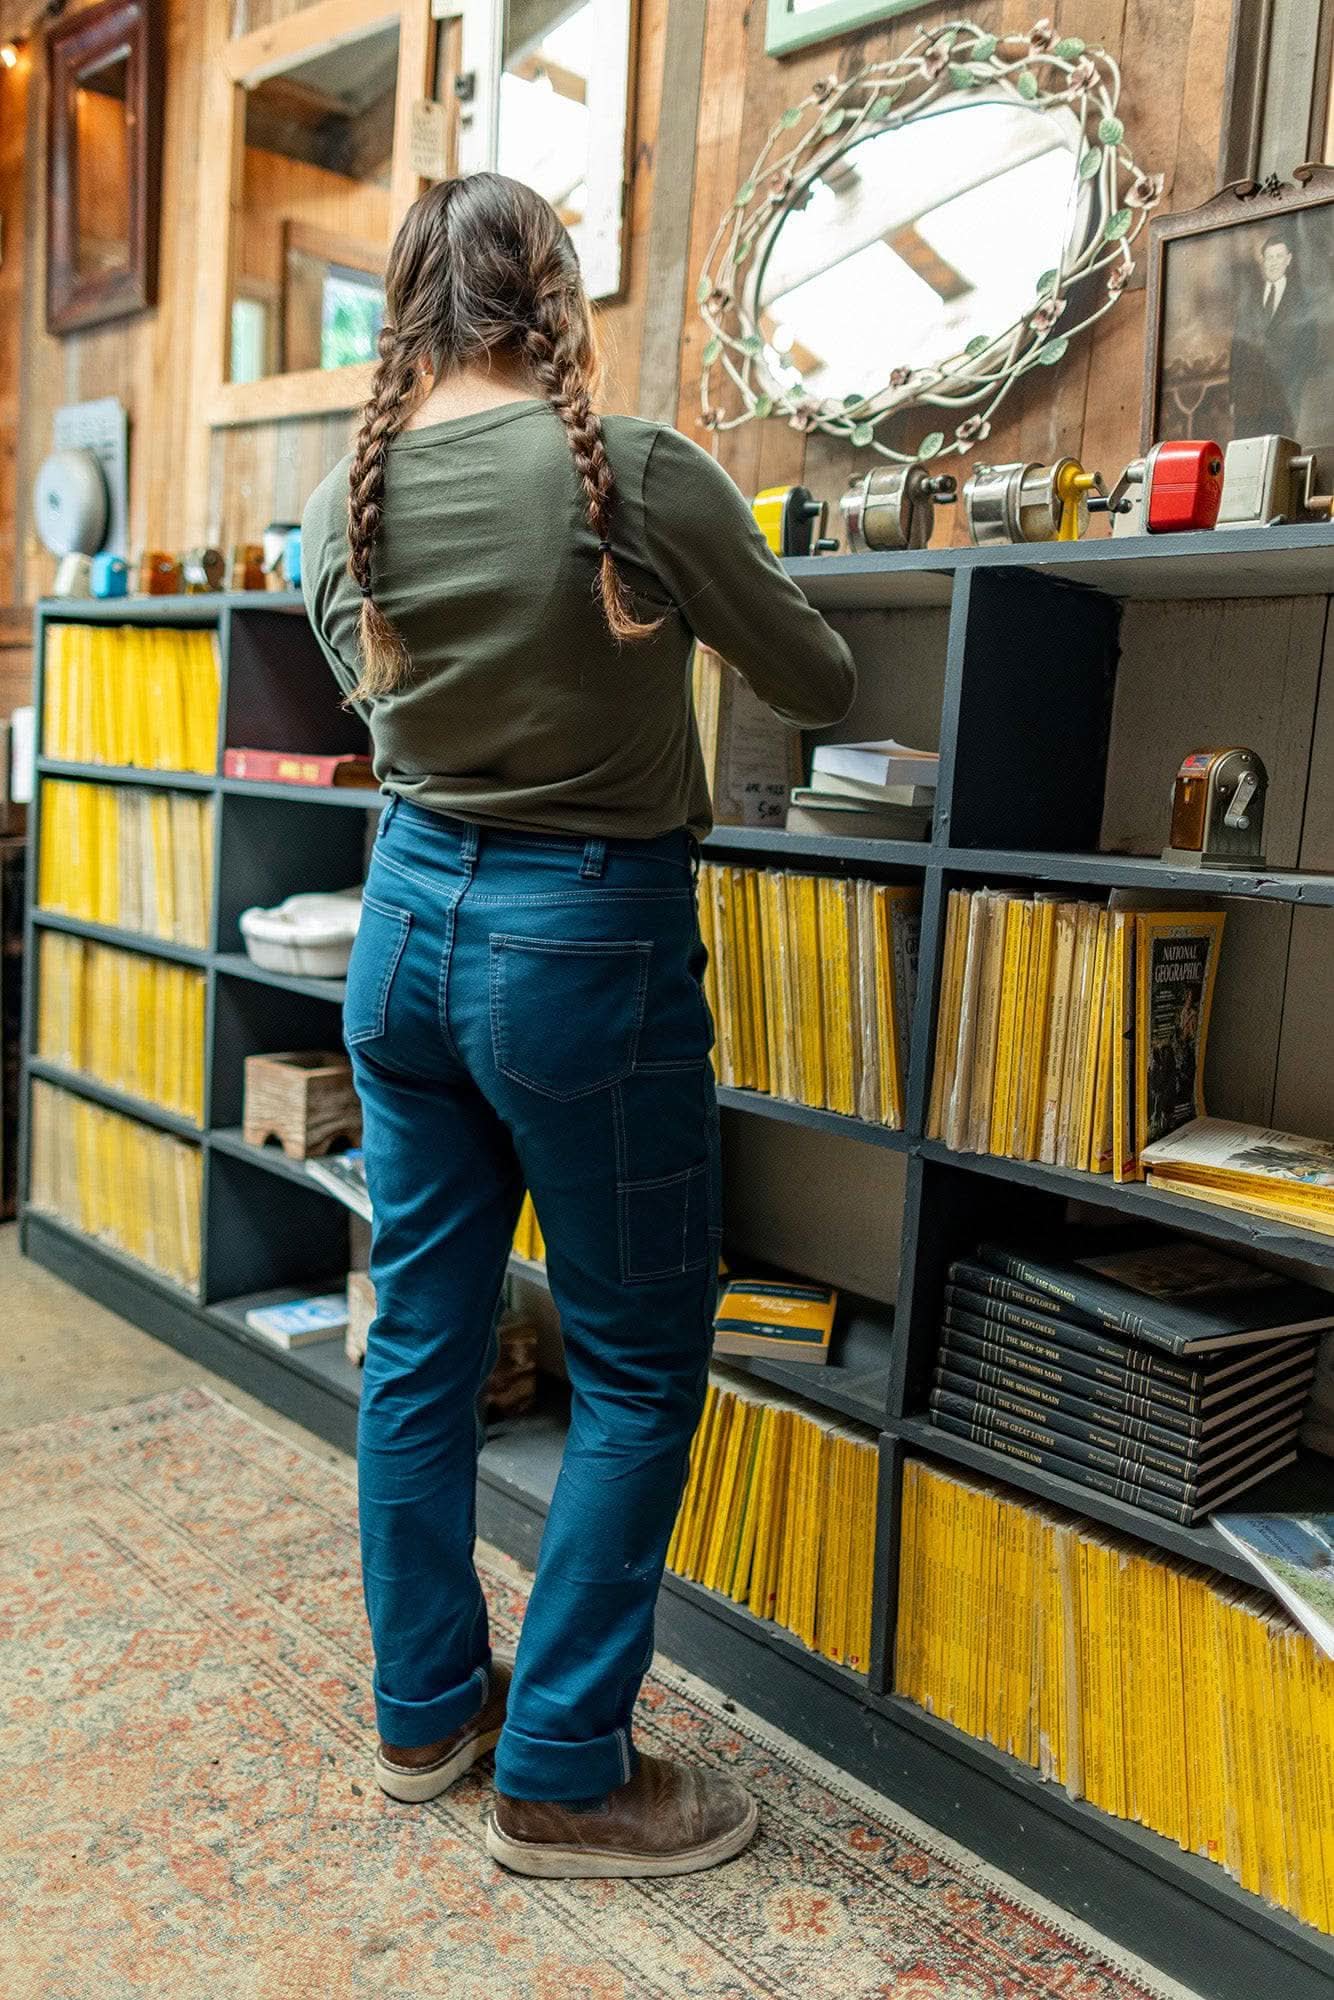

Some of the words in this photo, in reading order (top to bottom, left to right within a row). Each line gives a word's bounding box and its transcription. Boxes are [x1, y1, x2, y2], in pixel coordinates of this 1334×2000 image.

[1163, 945, 1197, 961] NATIONAL
[1155, 962, 1203, 983] GEOGRAPHIC
[1011, 1290, 1025, 1301] THE
[1025, 1295, 1061, 1313] EXPLORERS
[1008, 1313, 1020, 1323] THE
[1021, 1318, 1057, 1336] EXPLORERS
[1006, 1335, 1019, 1345] THE
[1004, 1356, 1018, 1367] THE
[1044, 1367, 1063, 1382] MAIN
[1002, 1377, 1015, 1387] THE
[1041, 1391, 1060, 1405] MAIN
[998, 1398, 1011, 1409] THE
[995, 1418, 1009, 1429] THE
[993, 1440, 1007, 1451] THE
[1007, 1445, 1042, 1464] VENETIANS
